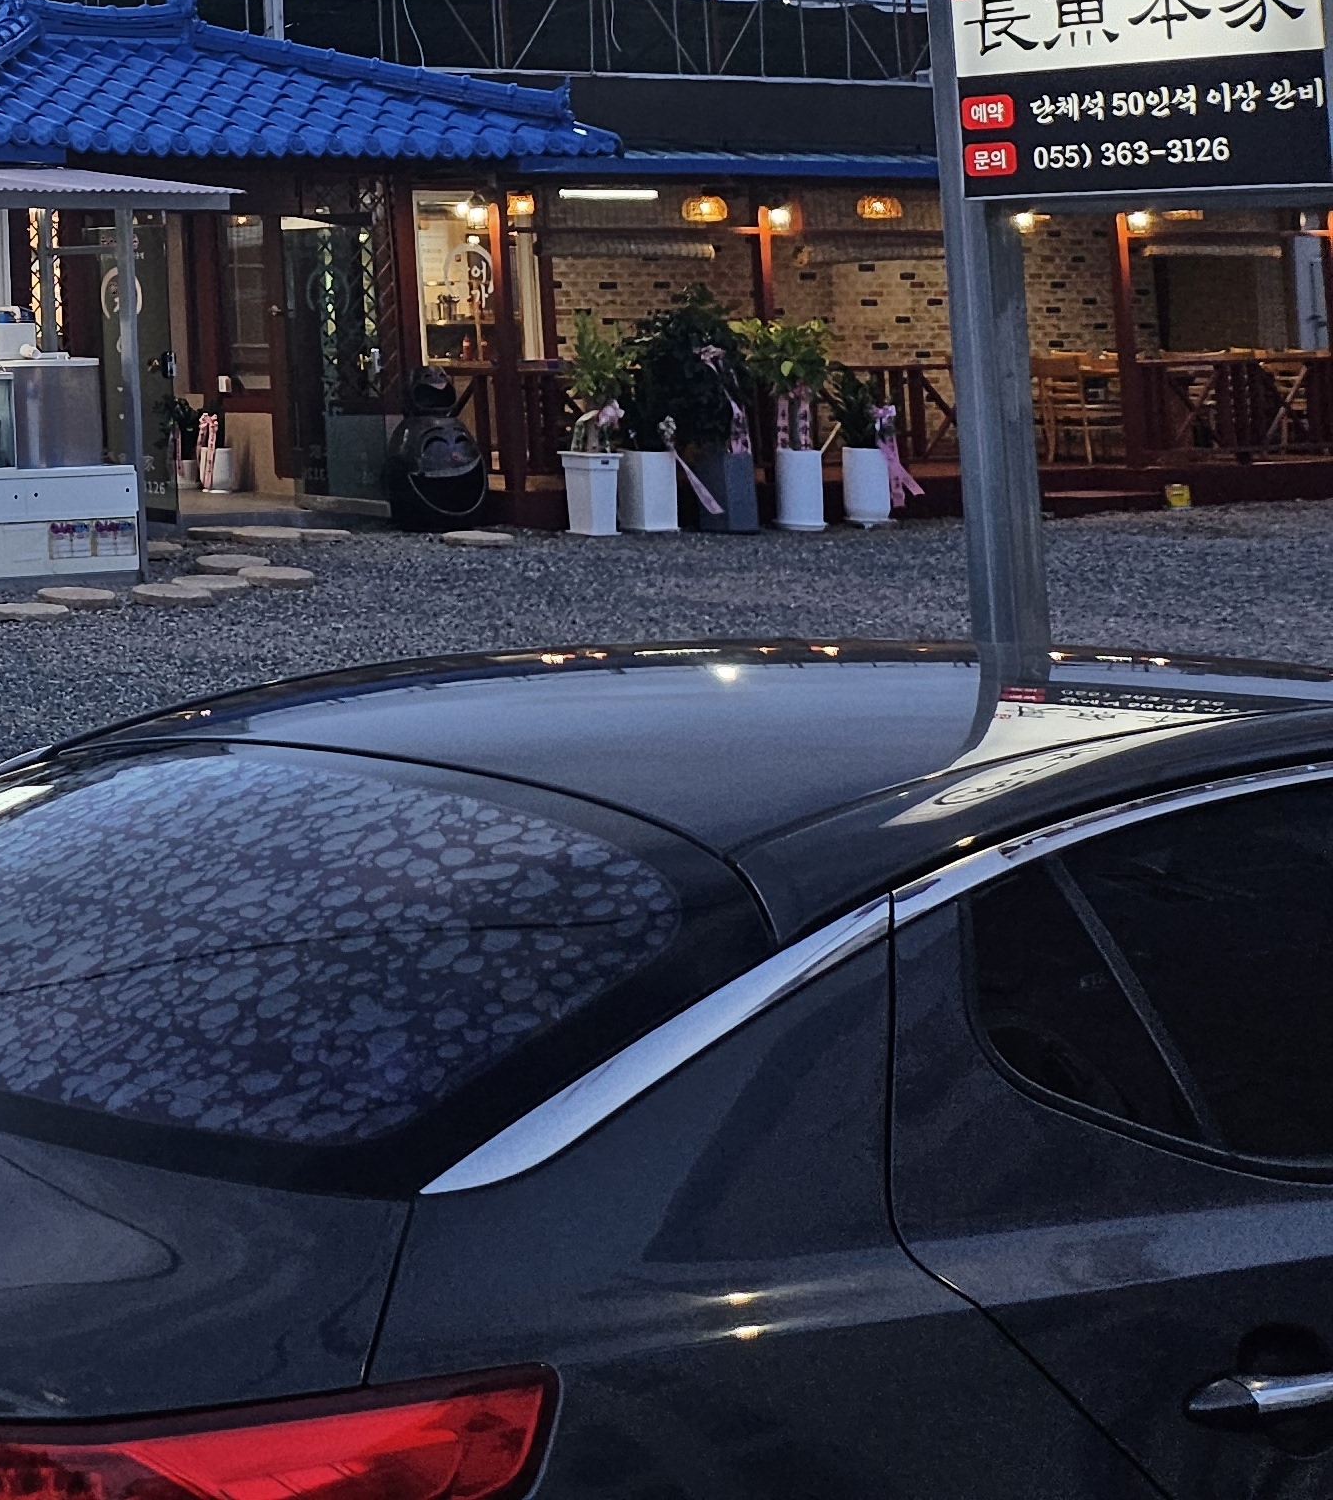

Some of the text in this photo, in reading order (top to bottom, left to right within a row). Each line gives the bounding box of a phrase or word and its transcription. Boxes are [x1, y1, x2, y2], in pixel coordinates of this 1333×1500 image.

[970, 77, 1324, 125] 예약 단체석 50인석 이상 완비
[973, 136, 1231, 170] 문의 055) 363-3126
